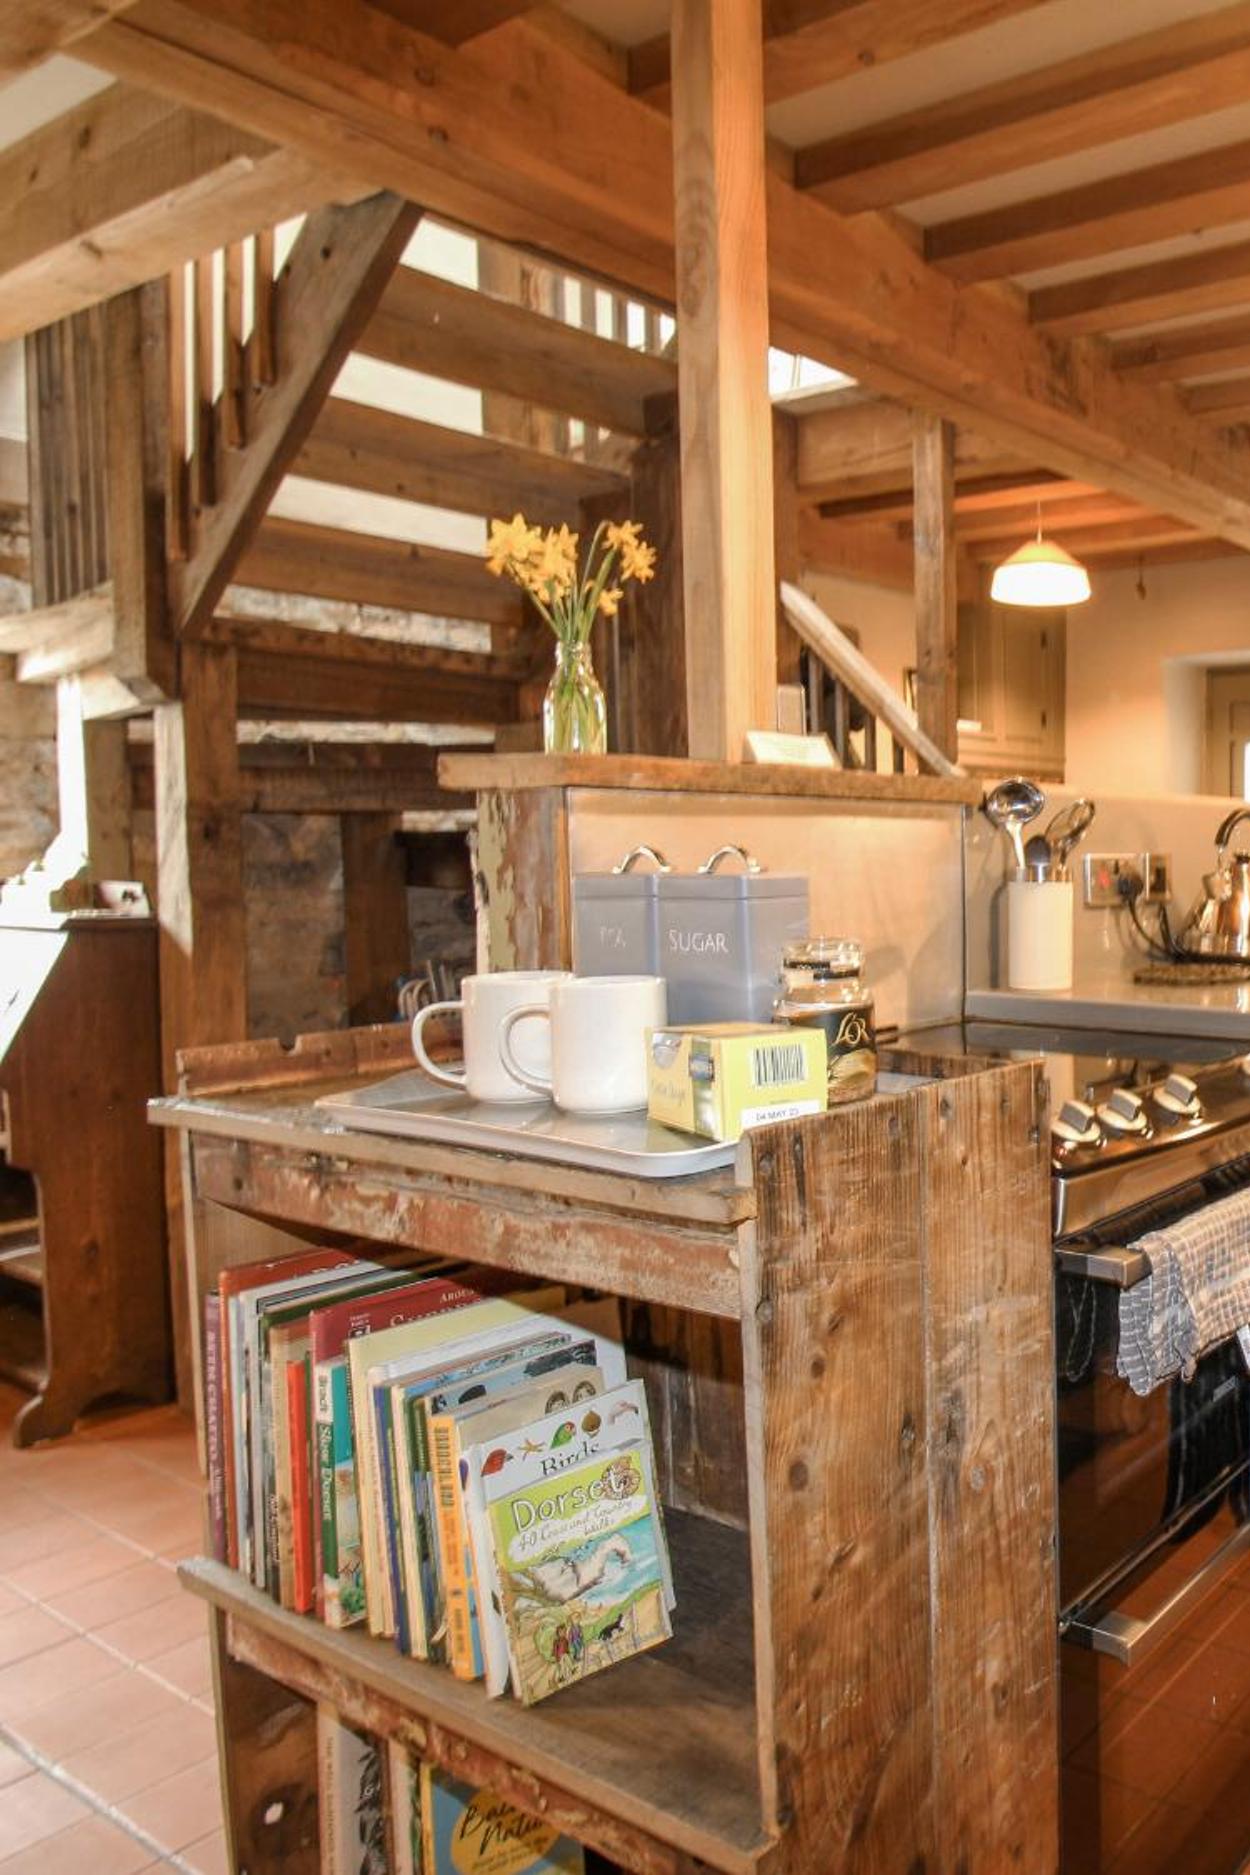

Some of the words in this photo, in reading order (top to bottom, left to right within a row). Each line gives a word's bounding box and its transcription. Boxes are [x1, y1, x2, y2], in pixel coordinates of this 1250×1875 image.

[668, 929, 729, 953] SUGAR
[768, 1109, 786, 1120] MAY
[540, 1441, 600, 1475] Birds
[511, 1464, 625, 1533] Dorset
